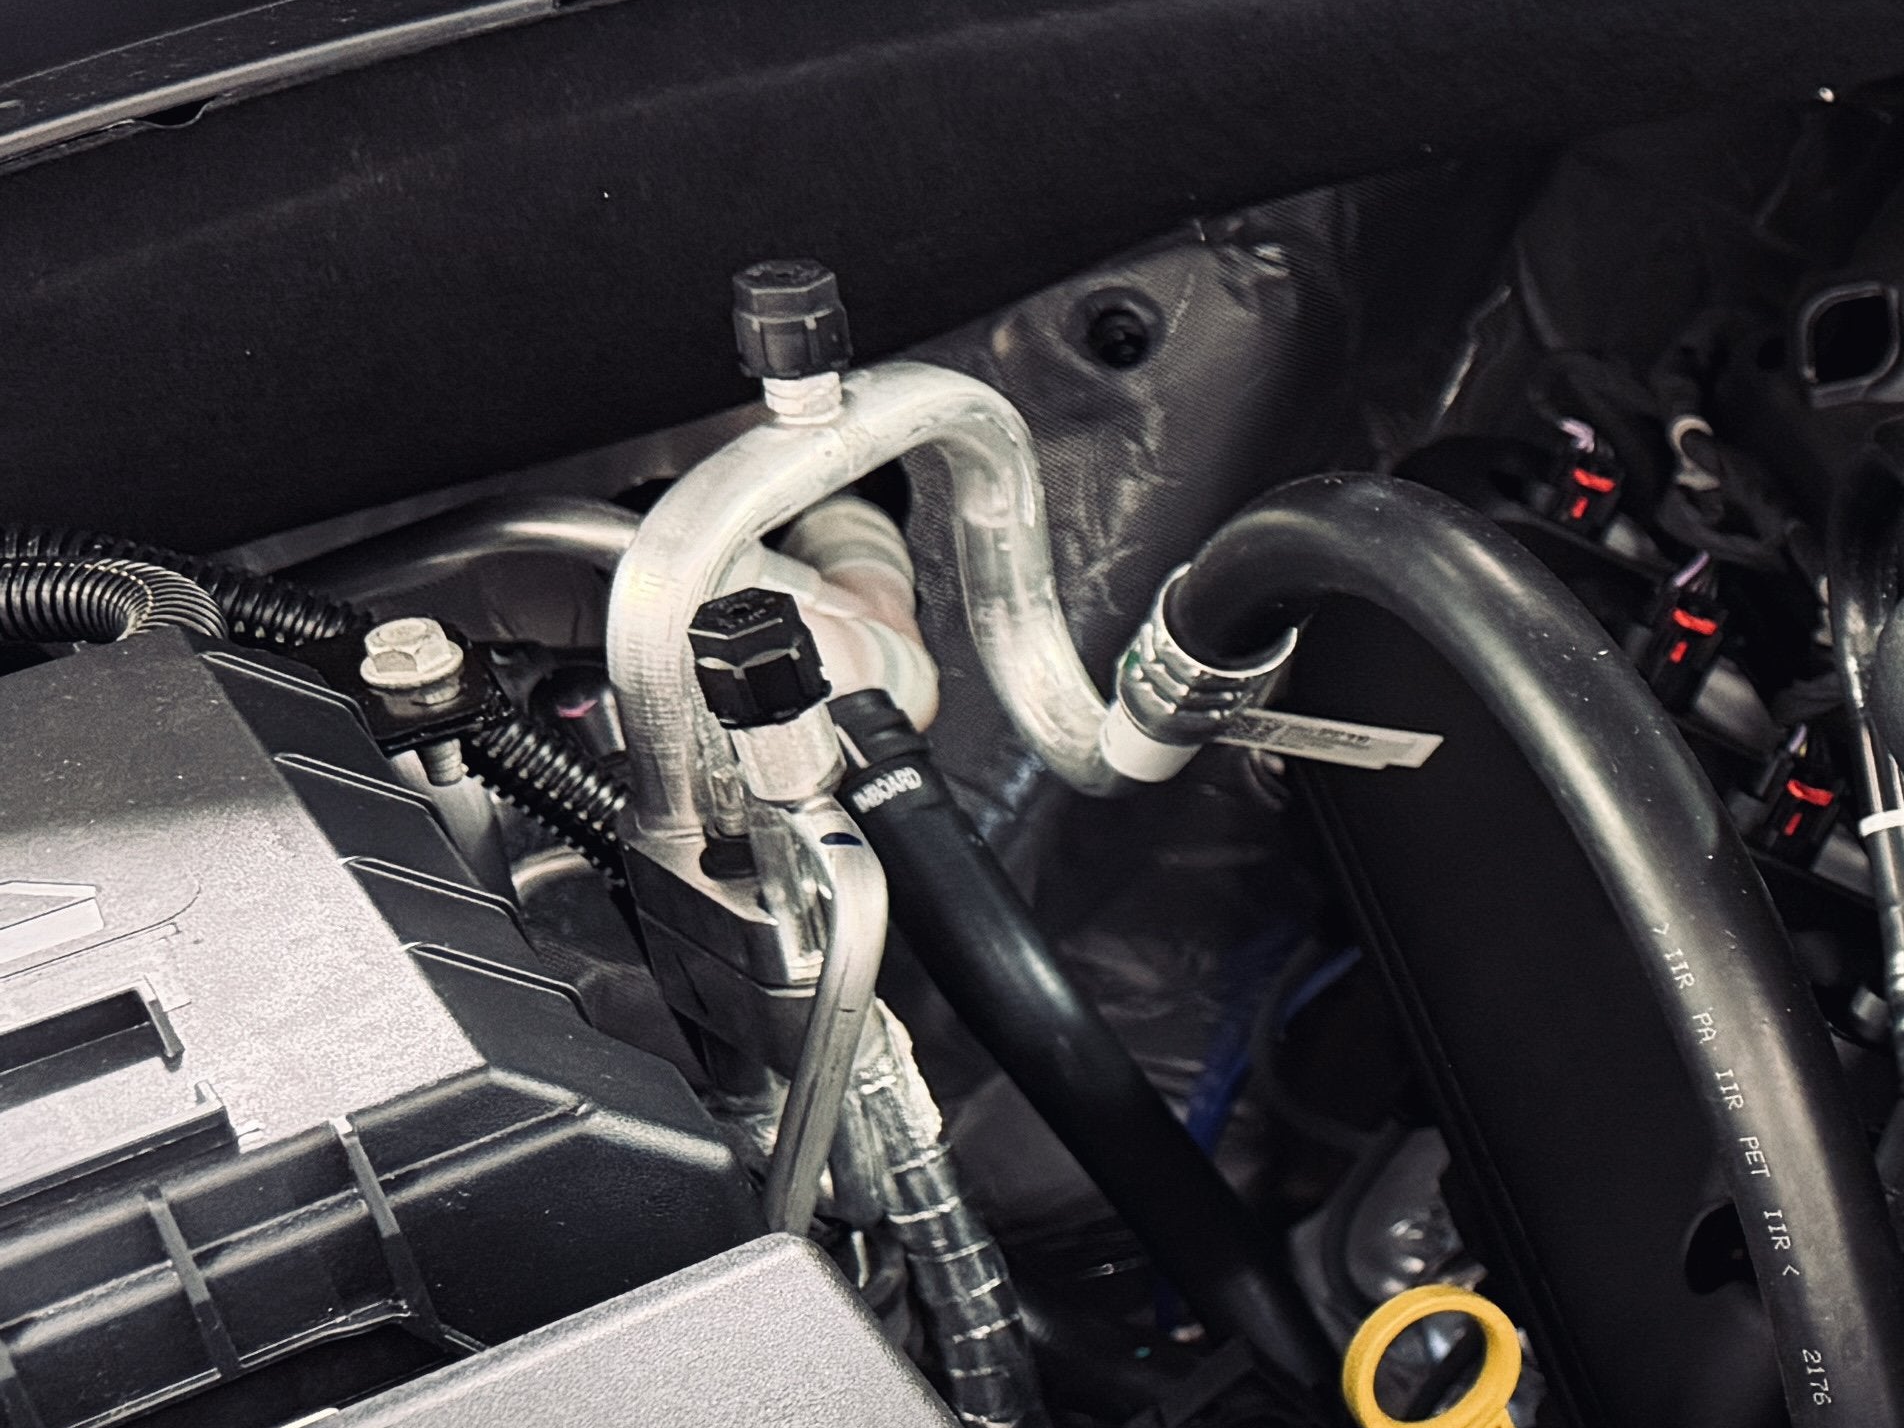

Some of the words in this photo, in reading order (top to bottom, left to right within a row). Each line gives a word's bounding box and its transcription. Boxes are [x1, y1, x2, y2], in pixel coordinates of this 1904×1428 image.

[1664, 948, 1695, 989] IIR
[1692, 1012, 1717, 1044] PA
[1715, 1069, 1744, 1110] IIR
[1739, 1136, 1771, 1177] PET
[1802, 1349, 1832, 1405] 2176
